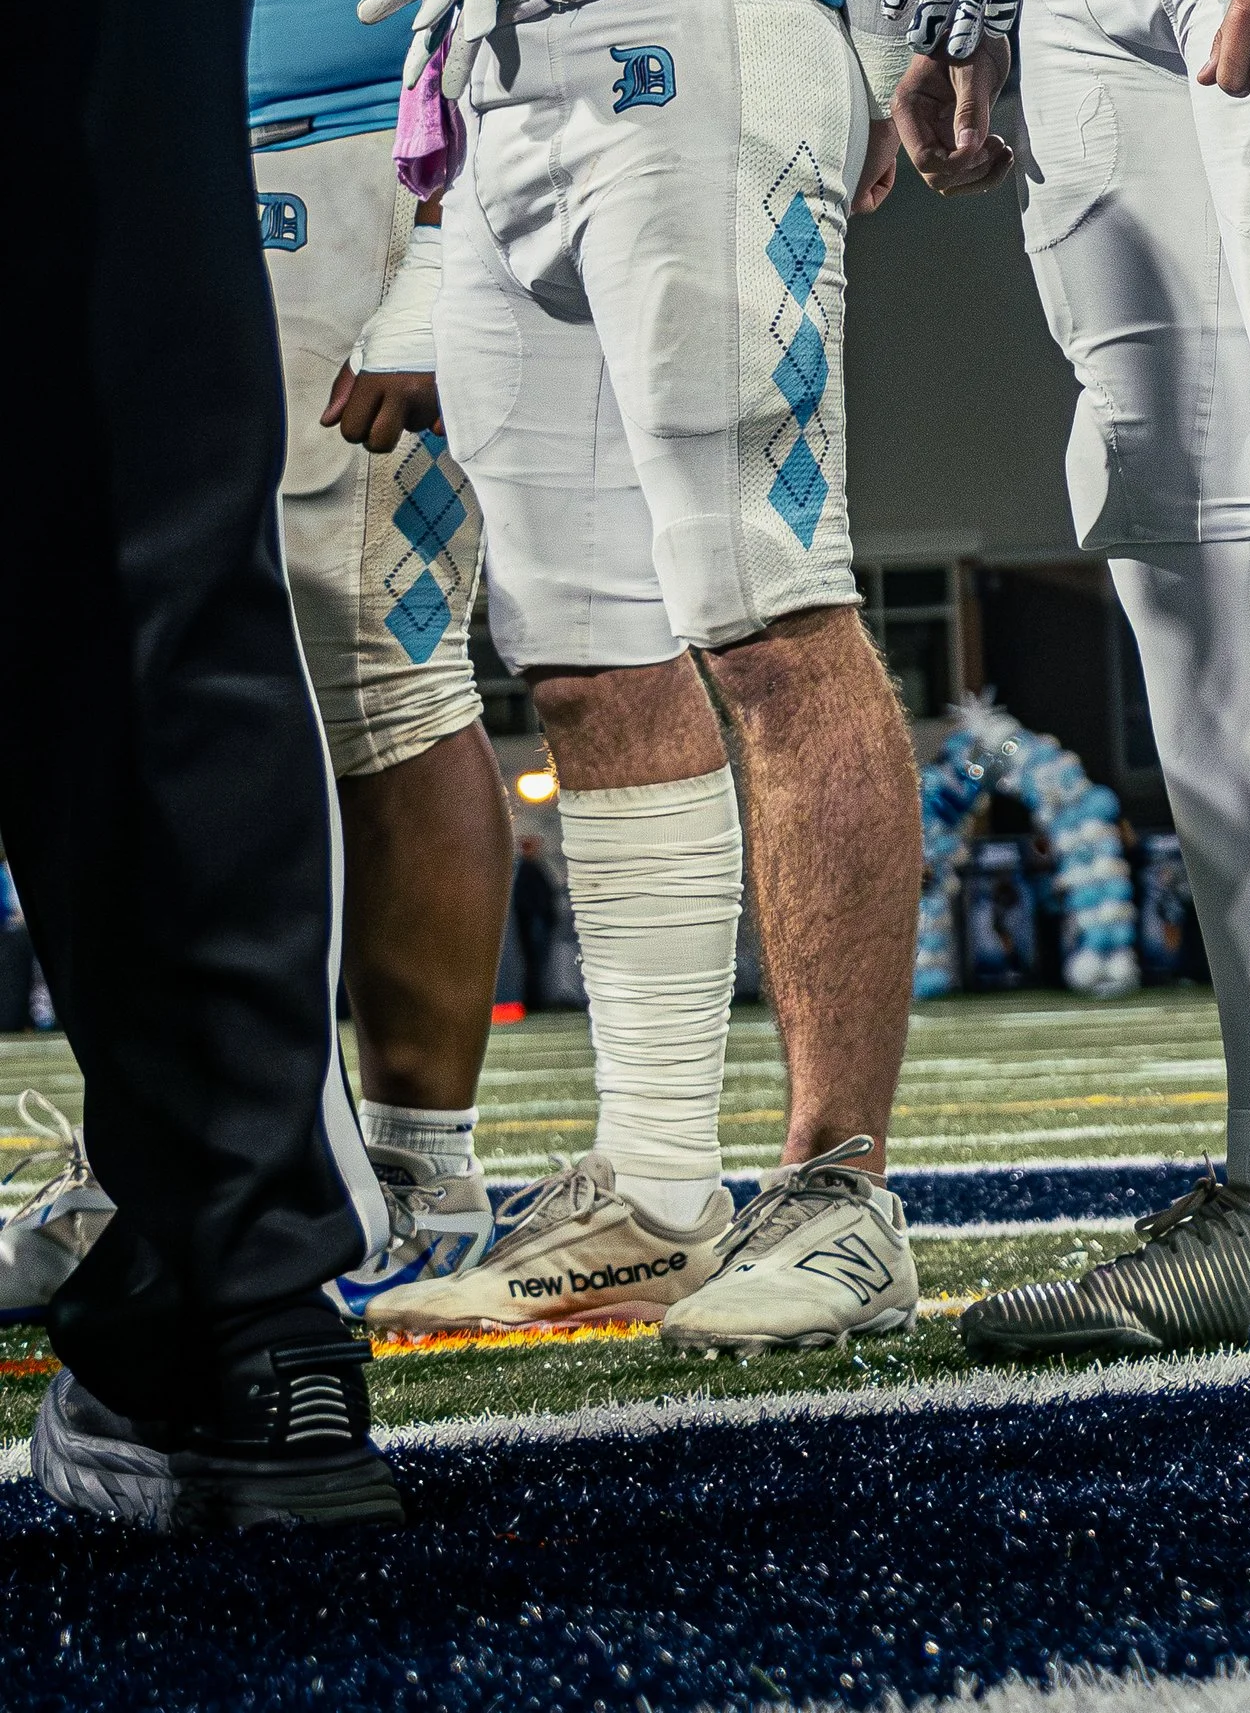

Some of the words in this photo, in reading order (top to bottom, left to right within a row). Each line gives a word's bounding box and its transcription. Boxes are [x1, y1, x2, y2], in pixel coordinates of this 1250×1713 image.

[609, 44, 677, 115] D
[508, 1276, 563, 1298] new
[568, 1251, 689, 1292] balance
